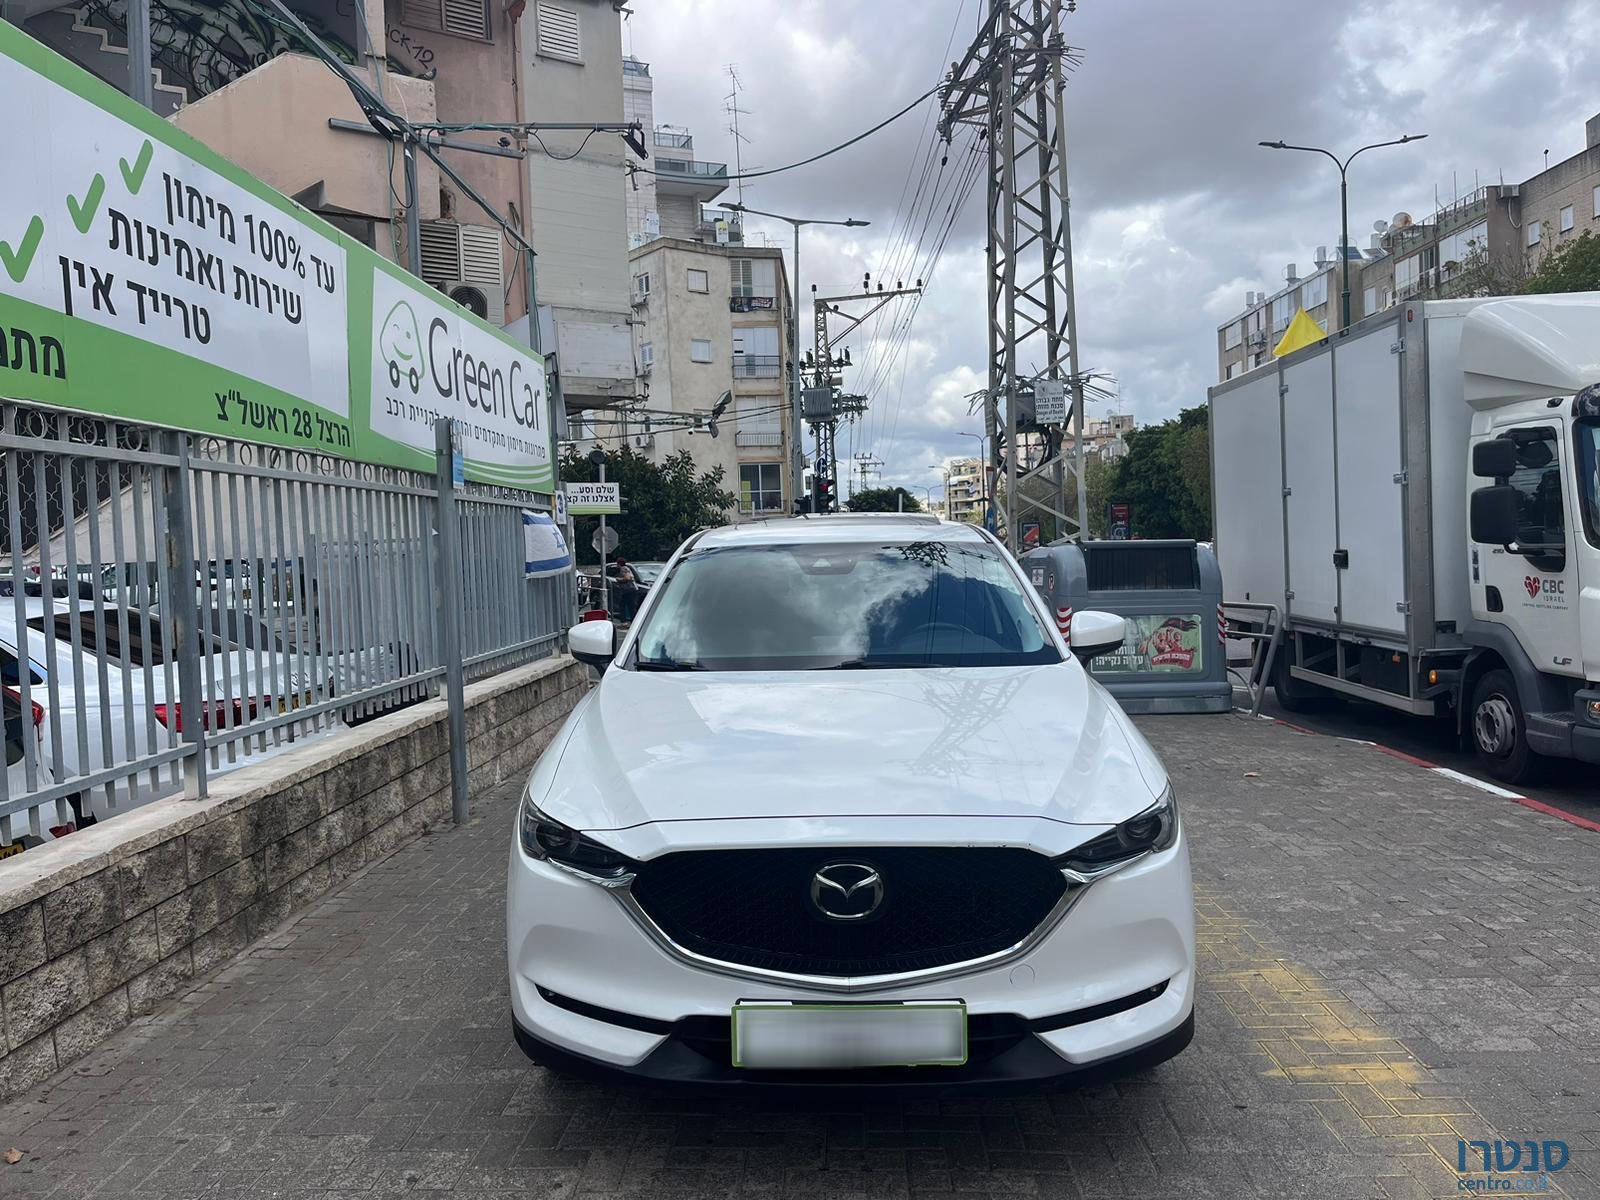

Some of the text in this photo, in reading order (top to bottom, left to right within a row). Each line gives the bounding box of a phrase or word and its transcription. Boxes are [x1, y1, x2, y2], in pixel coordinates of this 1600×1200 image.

[163, 172, 334, 293] עד 100% מימון
[108, 208, 301, 324] שירות ואמינות
[59, 255, 211, 344] טרייד אין
[429, 317, 540, 431] Green Car
[386, 397, 406, 419] רכב
[292, 408, 313, 439] 28
[316, 412, 350, 447] הרצל
[474, 425, 505, 448] מתקדמים
[507, 435, 523, 453] מימון
[524, 441, 546, 459] פתרונות
[596, 485, 615, 493] שלם
[1542, 579, 1565, 594] CBC
[1553, 656, 1572, 666] LF
